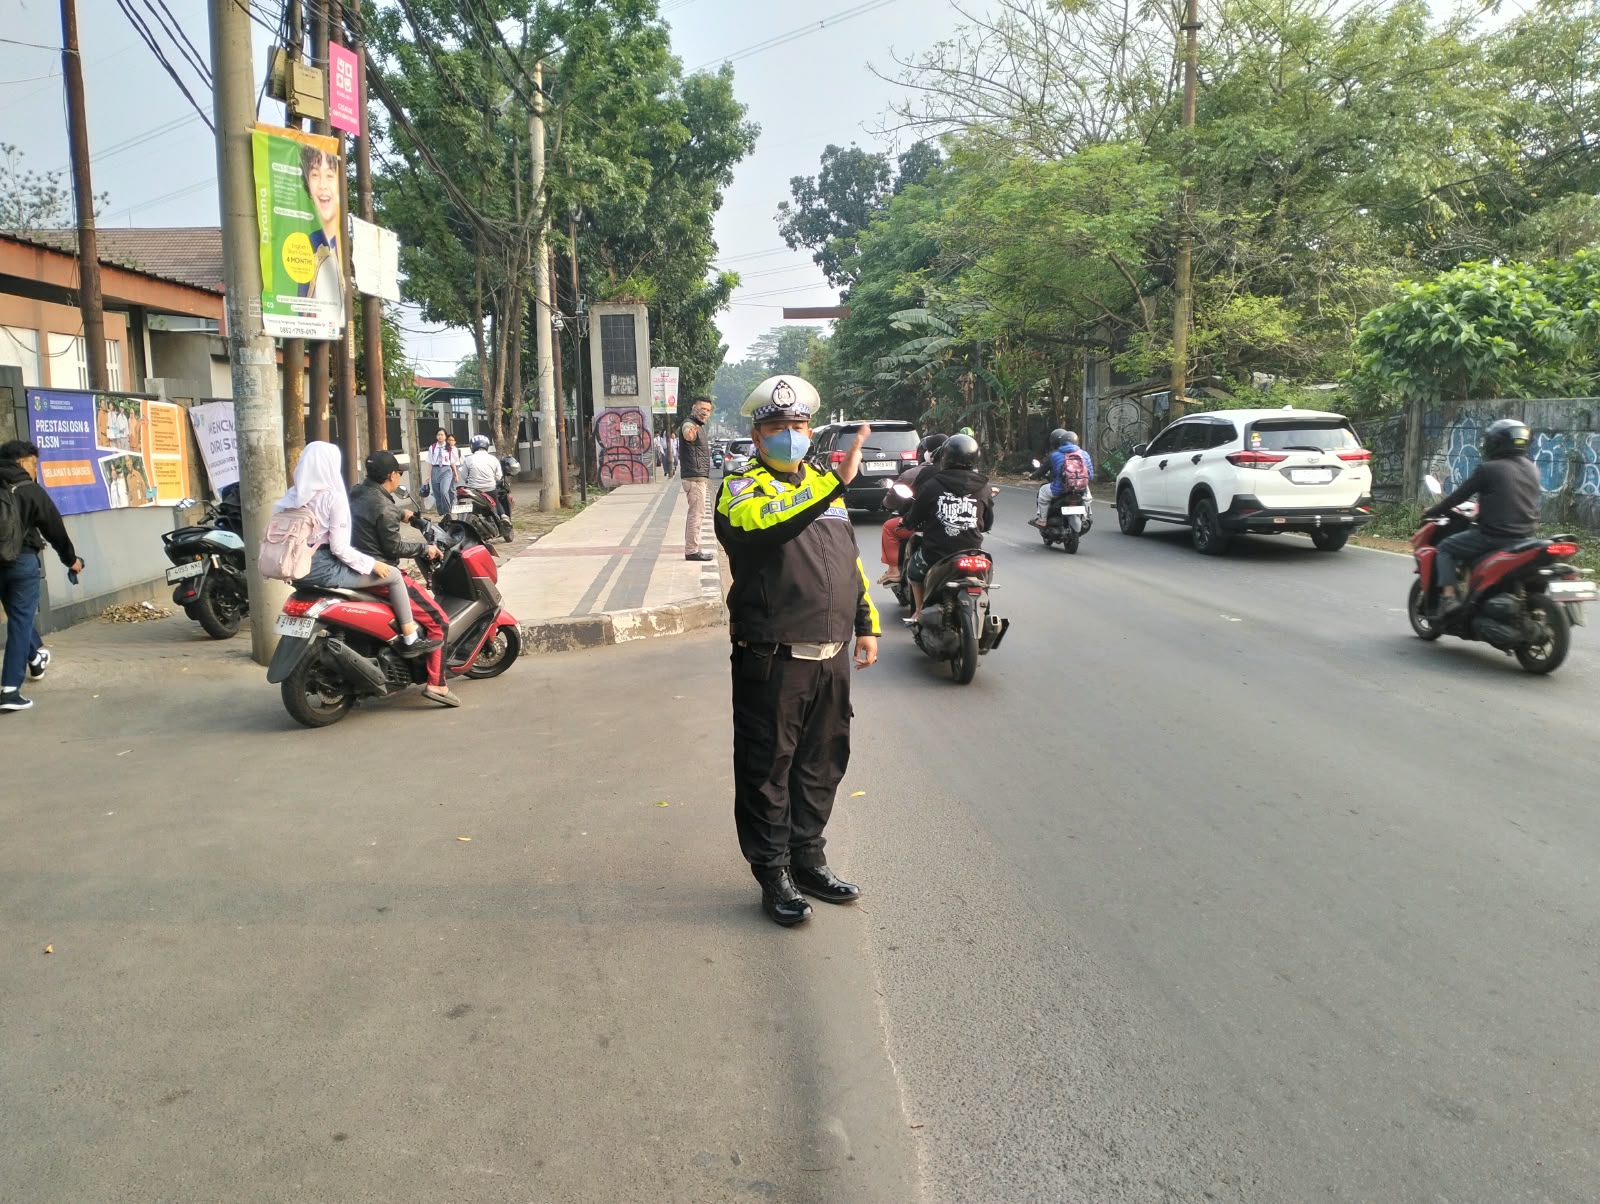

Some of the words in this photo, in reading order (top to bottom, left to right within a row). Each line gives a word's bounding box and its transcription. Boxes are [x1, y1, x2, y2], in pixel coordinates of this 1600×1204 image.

[35, 419, 69, 433] PRESTASI
[69, 420, 84, 433] OSN
[84, 420, 90, 433] &
[760, 486, 813, 519] POLISI
